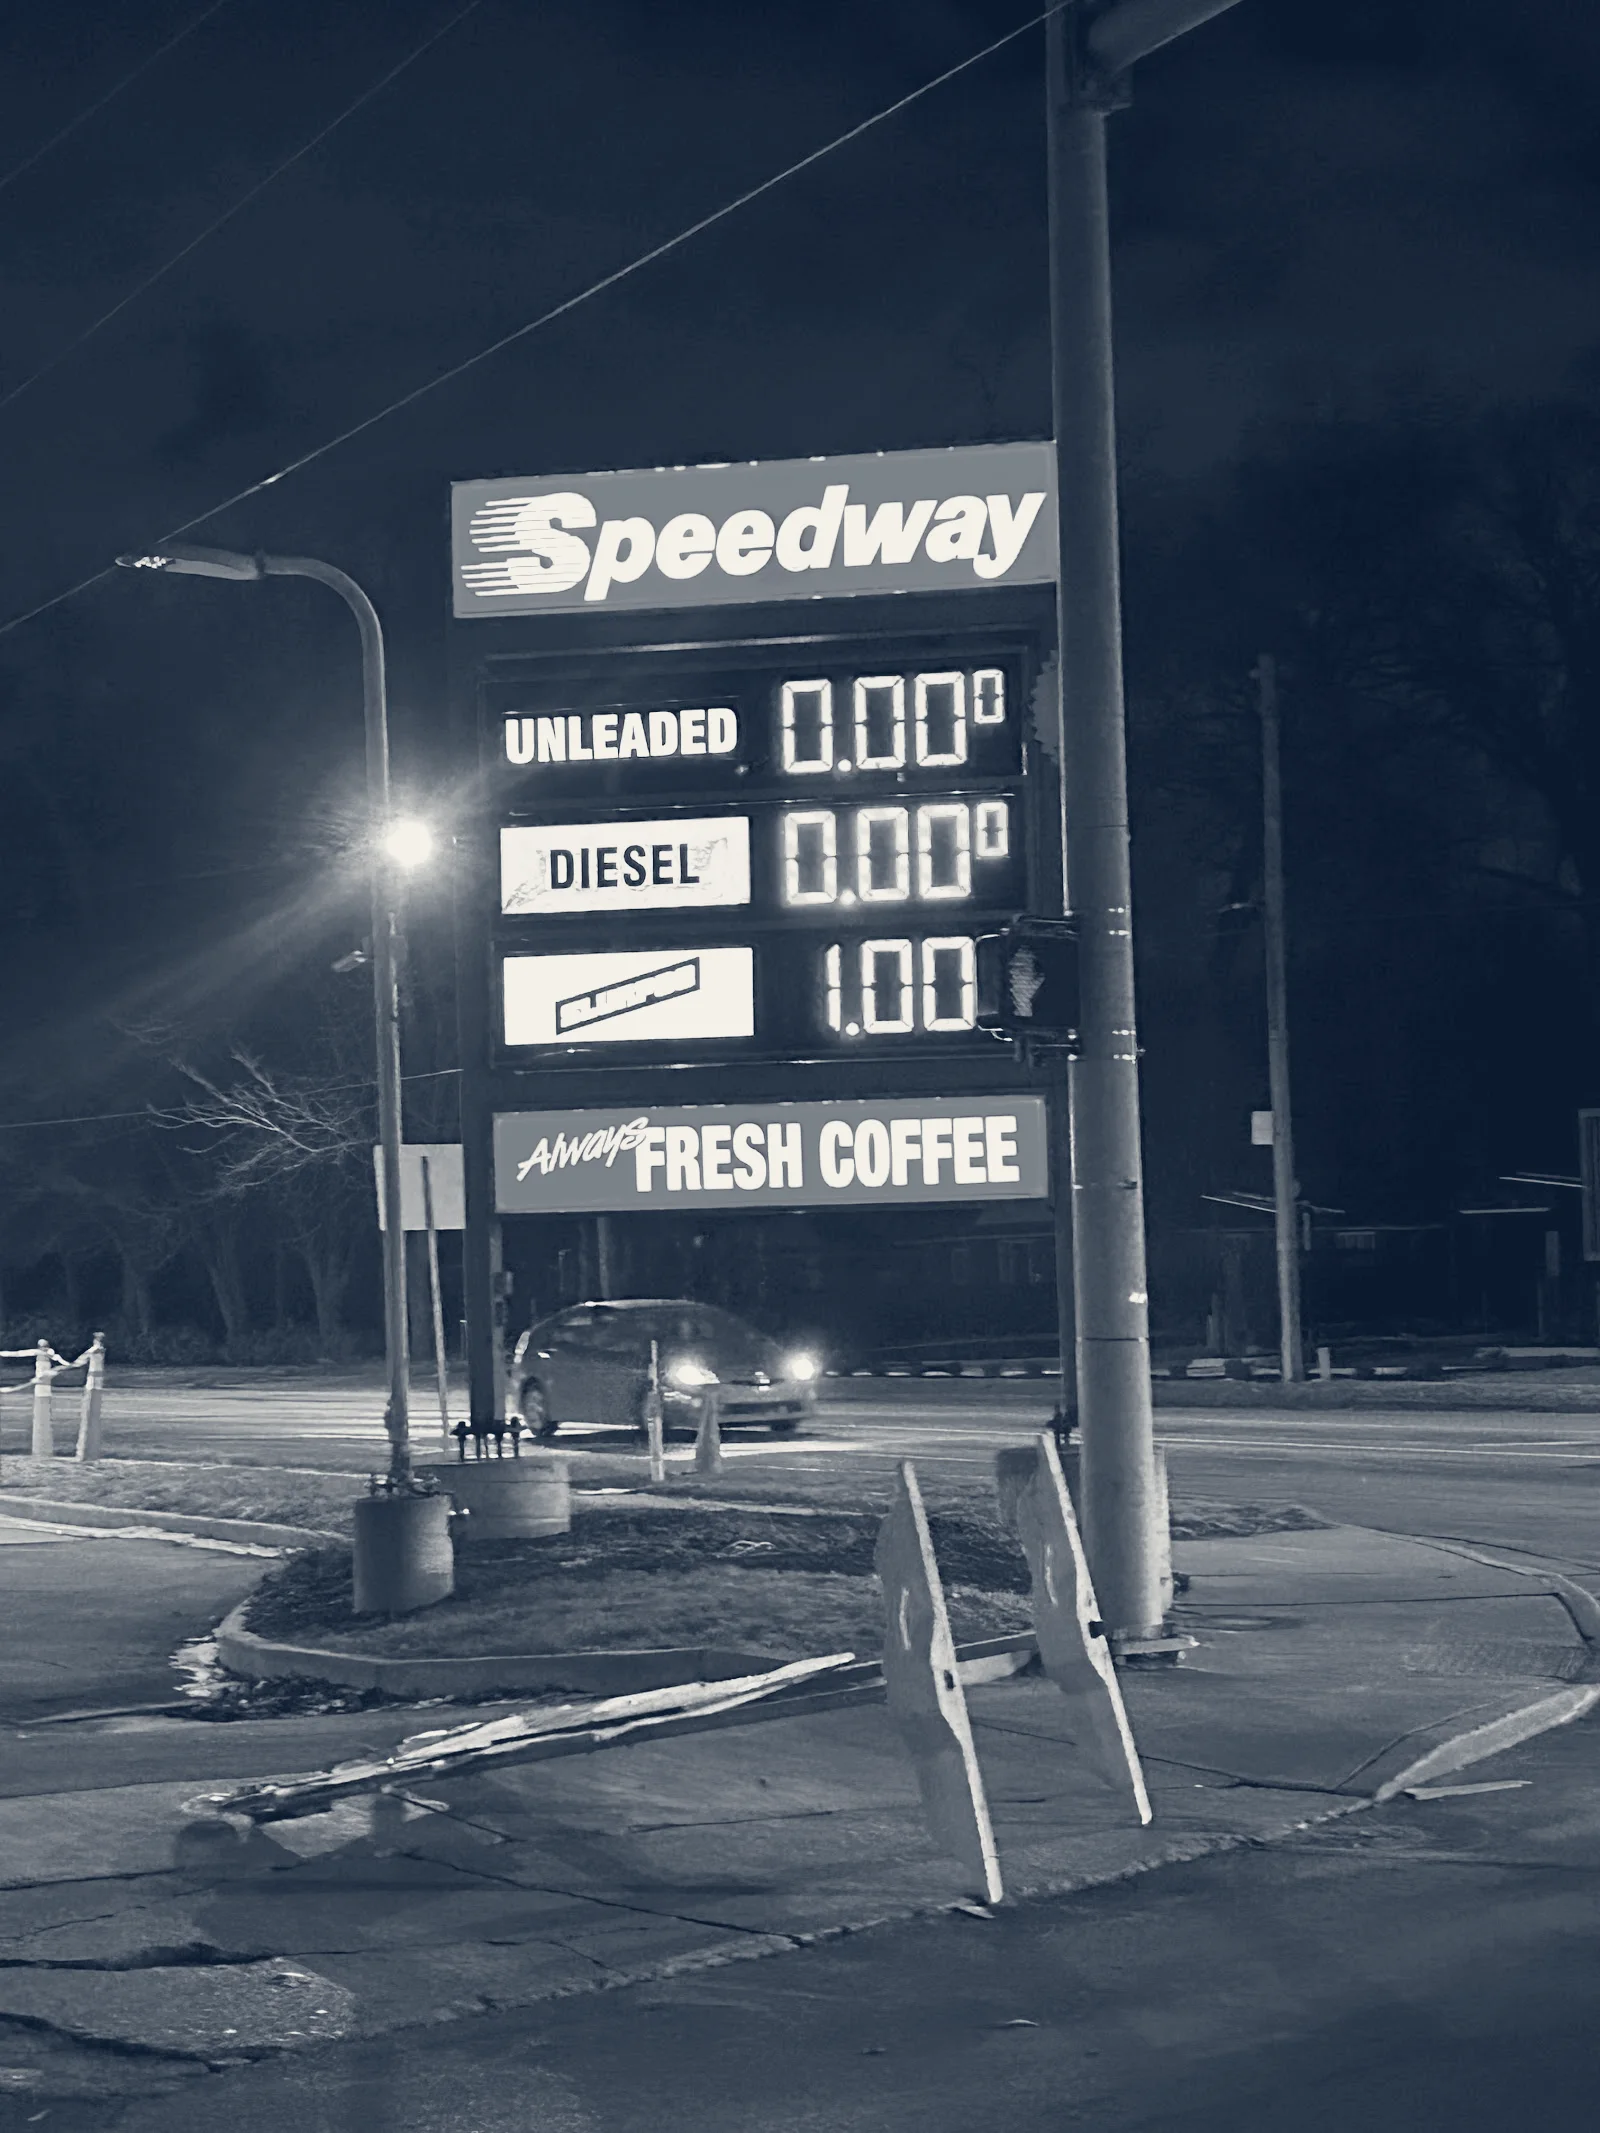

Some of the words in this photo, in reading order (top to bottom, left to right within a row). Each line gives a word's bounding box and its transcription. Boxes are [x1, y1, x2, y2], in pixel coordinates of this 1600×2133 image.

[461, 485, 1047, 601] Speedway
[505, 707, 738, 764] UNLEADED
[550, 843, 700, 890] DIESEL
[516, 1116, 649, 1182] Always
[635, 1121, 803, 1193] FRESH
[819, 1115, 1021, 1188] COFFEE
